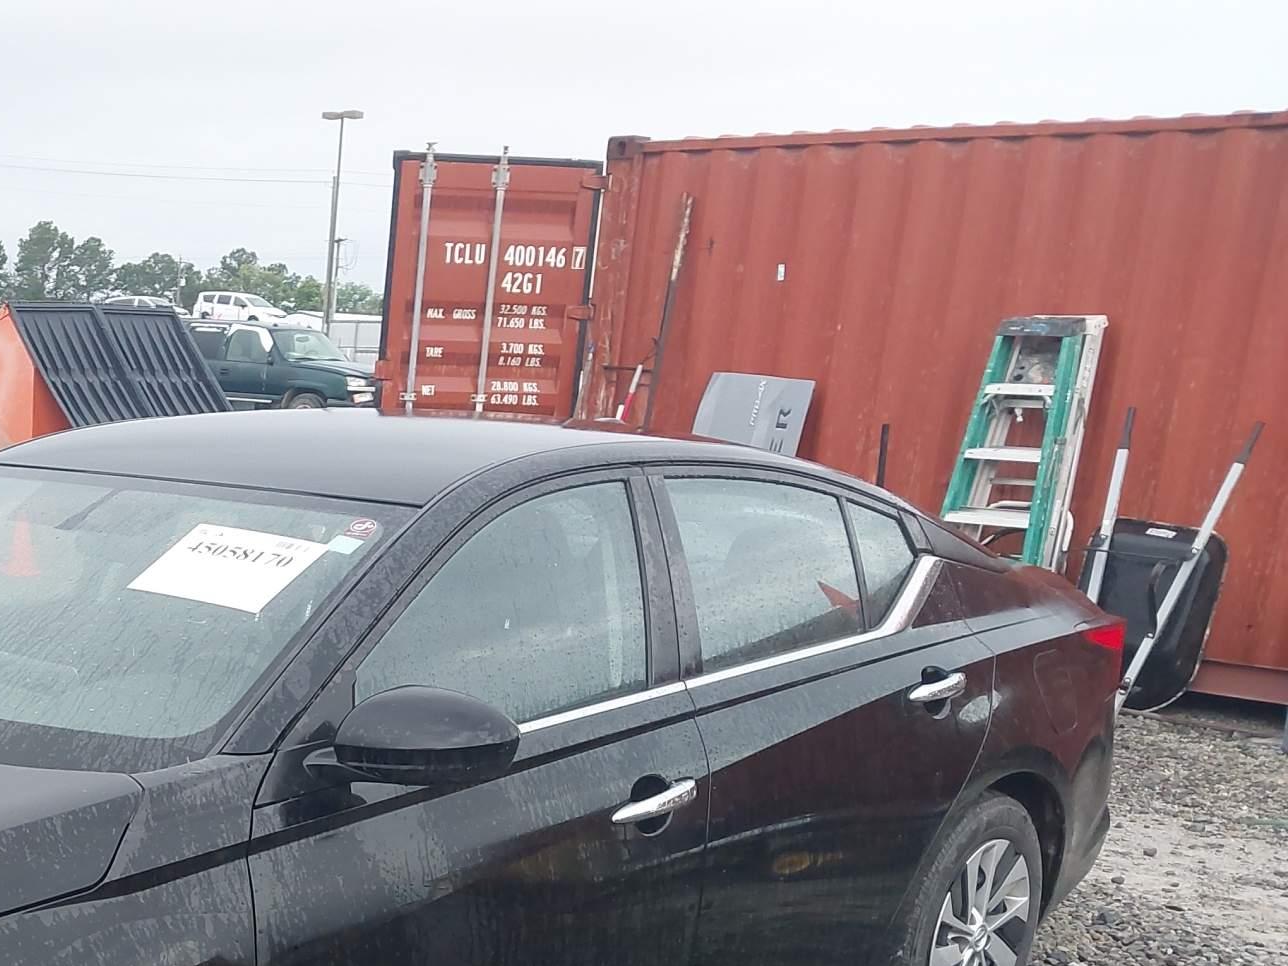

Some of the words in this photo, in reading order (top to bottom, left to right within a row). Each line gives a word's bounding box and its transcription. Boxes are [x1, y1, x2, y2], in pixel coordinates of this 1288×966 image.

[444, 242, 486, 265] TCLU
[504, 245, 567, 268] 400146
[574, 248, 586, 268] 7
[501, 272, 543, 294] 42G1
[453, 308, 477, 320] GROSS
[529, 318, 546, 330] LBS.
[426, 347, 444, 358] TARE
[528, 344, 545, 355] KGS.
[525, 358, 542, 367] LBS.
[421, 384, 435, 396] NET
[522, 395, 539, 406] LBS.
[187, 541, 294, 568] 45058170
